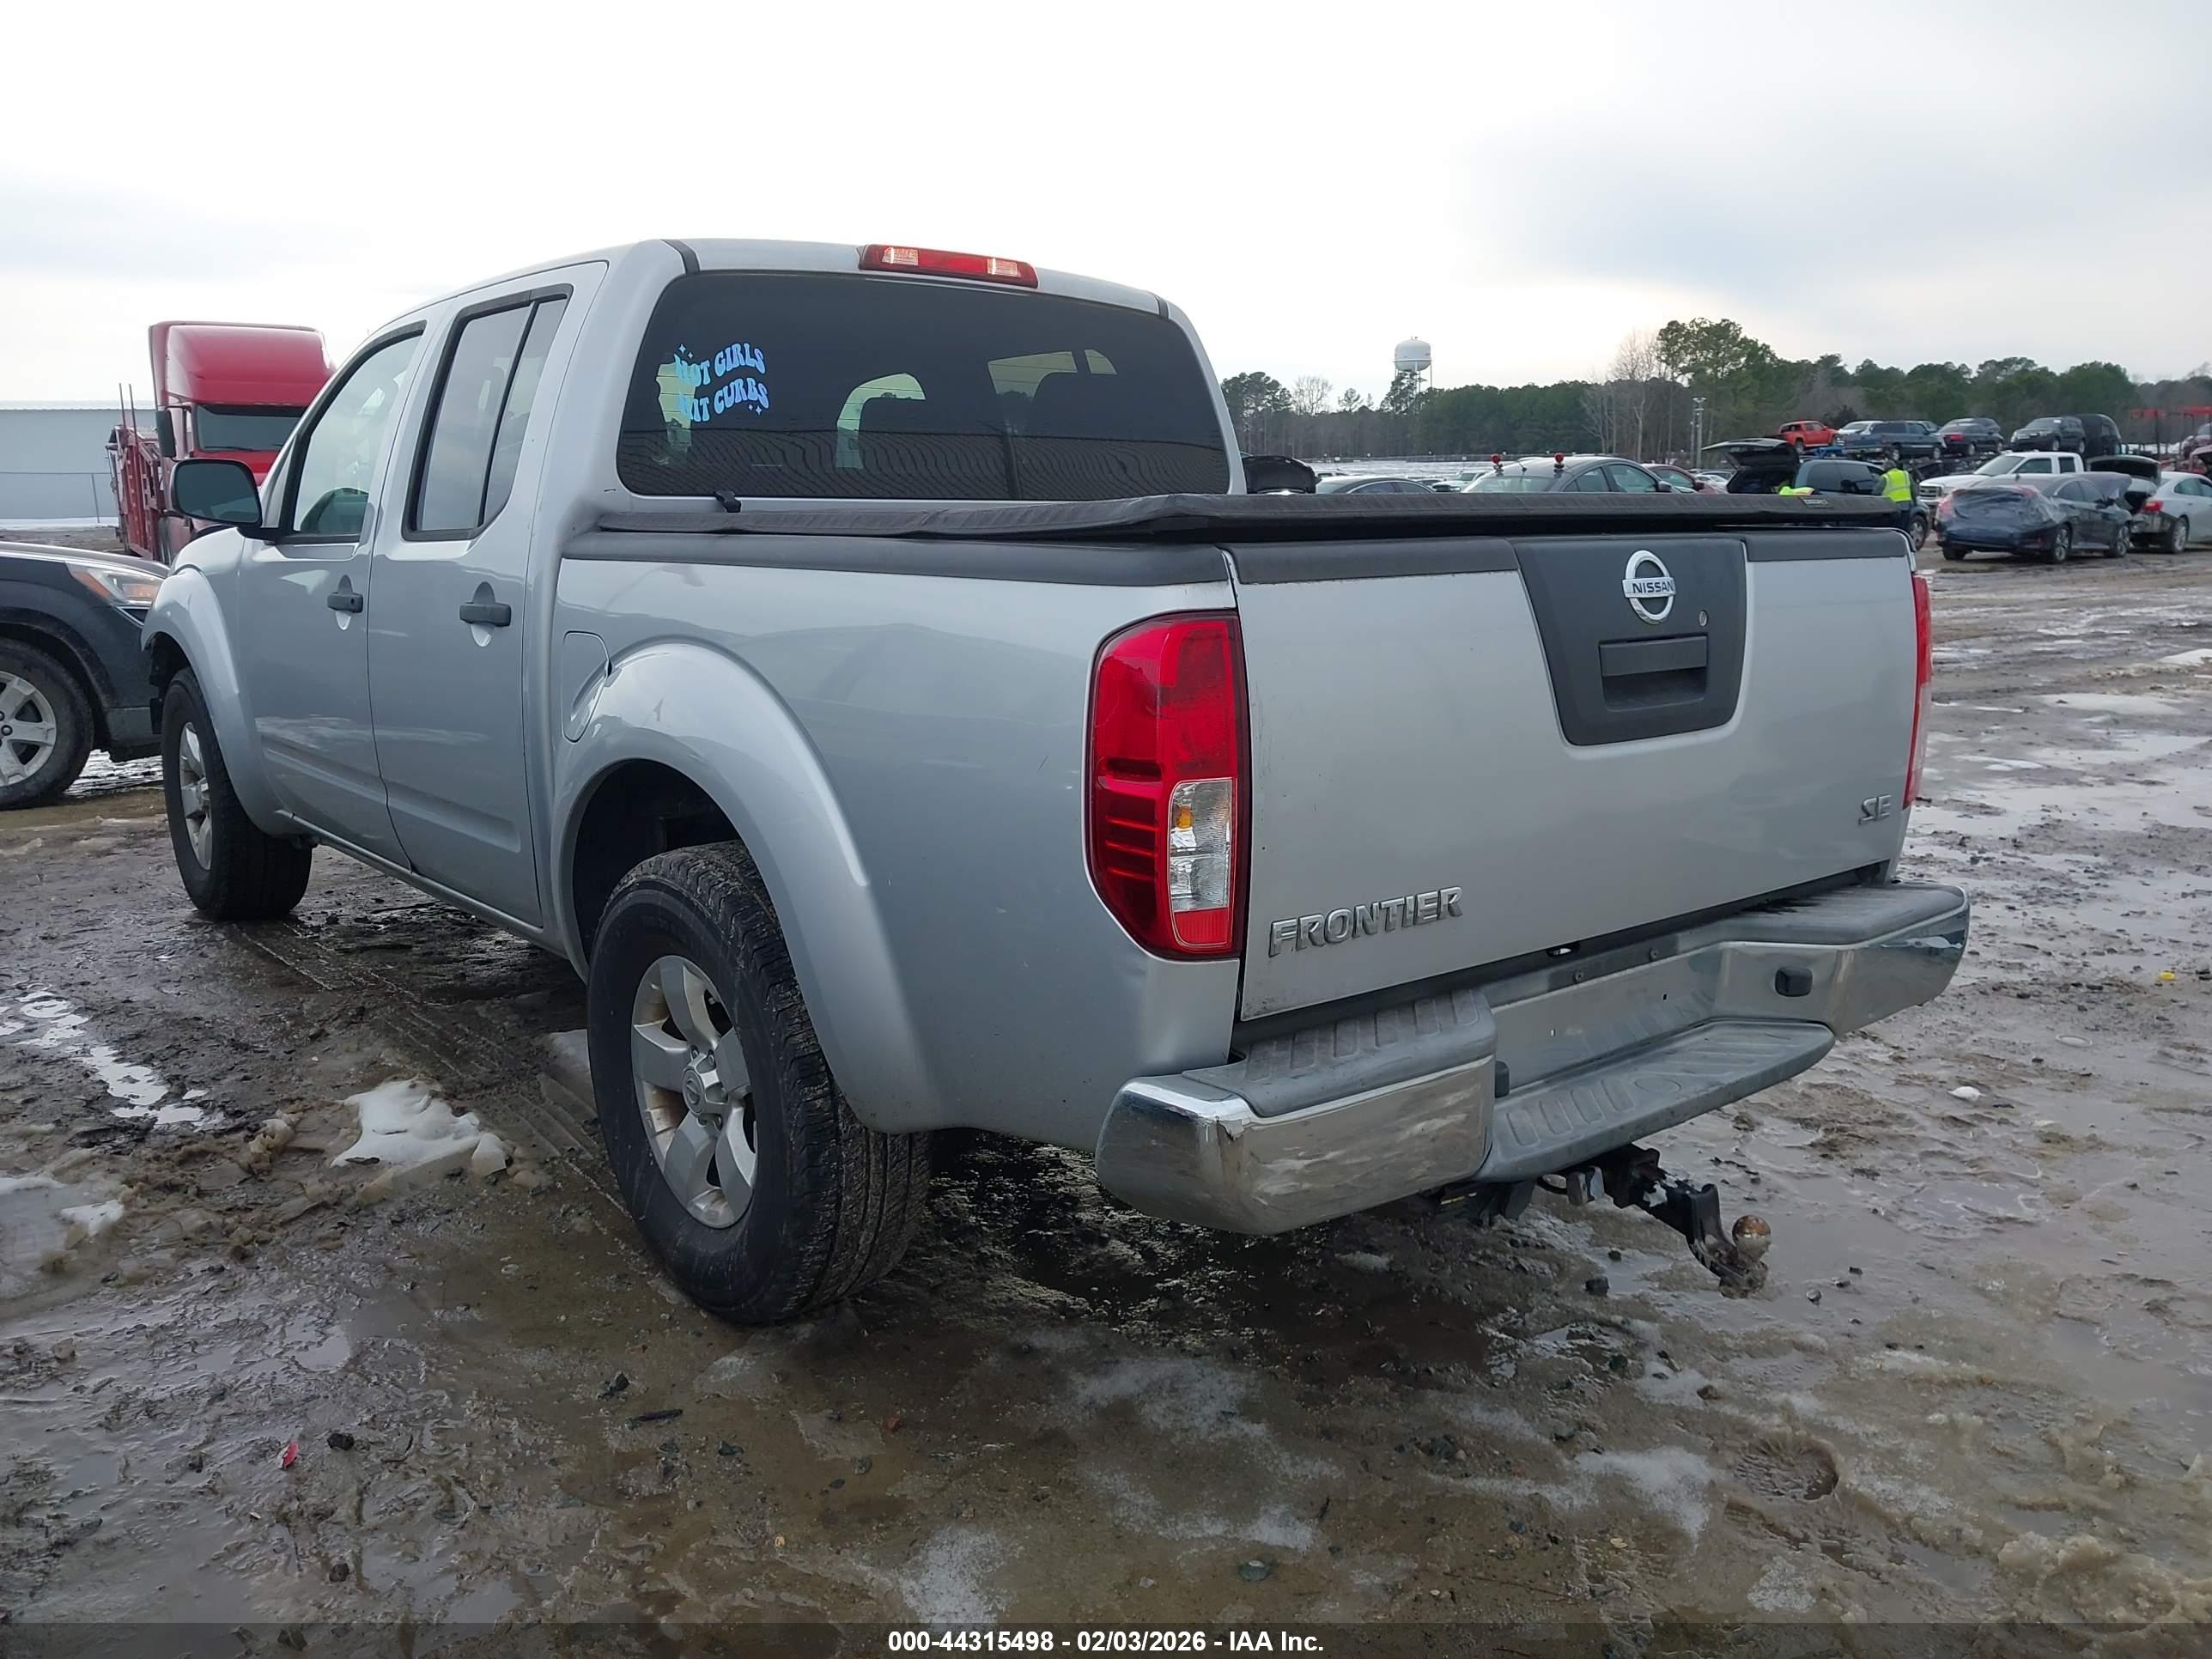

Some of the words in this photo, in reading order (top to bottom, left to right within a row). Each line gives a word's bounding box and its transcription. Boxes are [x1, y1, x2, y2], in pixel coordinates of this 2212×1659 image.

[714, 343, 766, 377] GIRLS
[714, 377, 769, 415] CURBS
[1632, 580, 1674, 594] NISSAN
[1859, 793, 1892, 823] SE
[1268, 885, 1463, 958] FRONTIER
